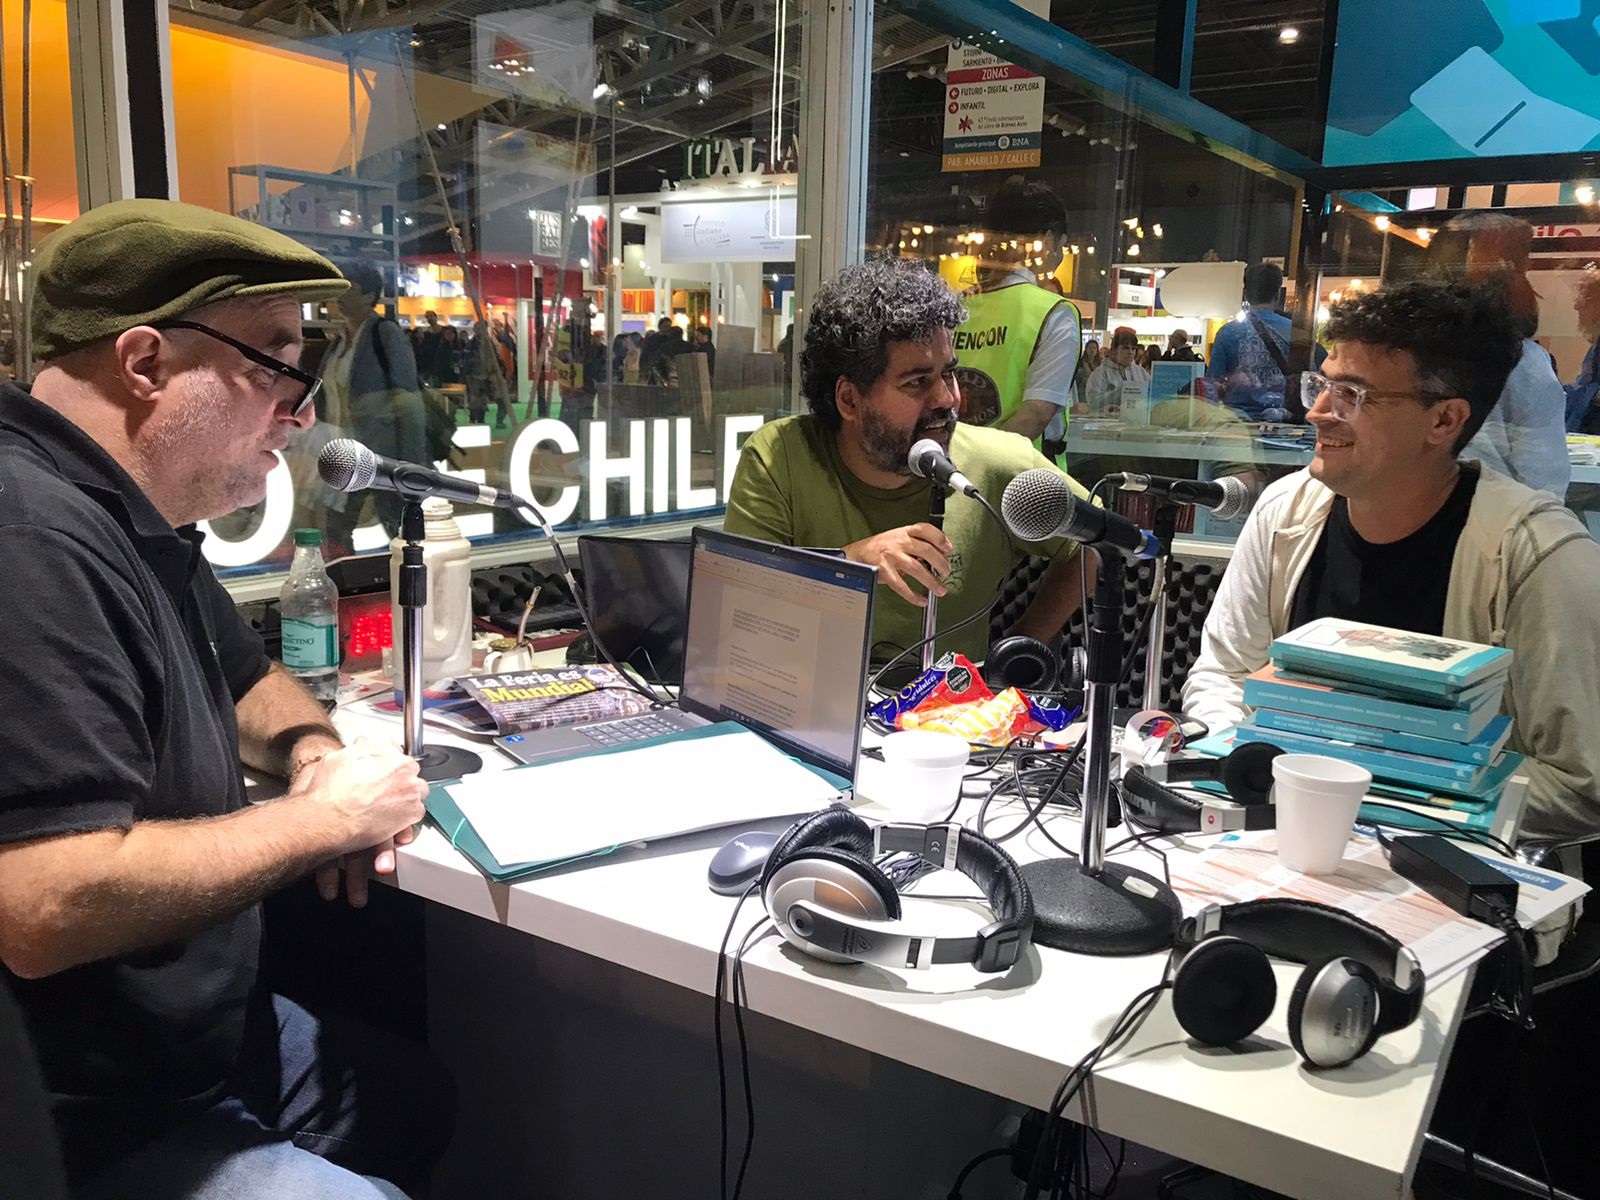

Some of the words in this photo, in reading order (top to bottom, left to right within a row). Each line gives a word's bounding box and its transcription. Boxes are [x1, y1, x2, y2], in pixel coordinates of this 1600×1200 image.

[963, 58, 992, 67] SARMIENTO
[982, 67, 1009, 80] ZONAS
[961, 87, 983, 96] FUTURO
[987, 85, 1009, 94] DIGITAL
[1013, 82, 1040, 92] EXPLORA
[961, 102, 986, 110] INFANTIL
[1012, 138, 1030, 147] BNA
[965, 155, 999, 166] AMARILLO
[1006, 153, 1029, 163] CALLE
[468, 678, 502, 689] La
[498, 672, 558, 686] Feria
[558, 670, 583, 681] es
[480, 678, 597, 703] Mundial
